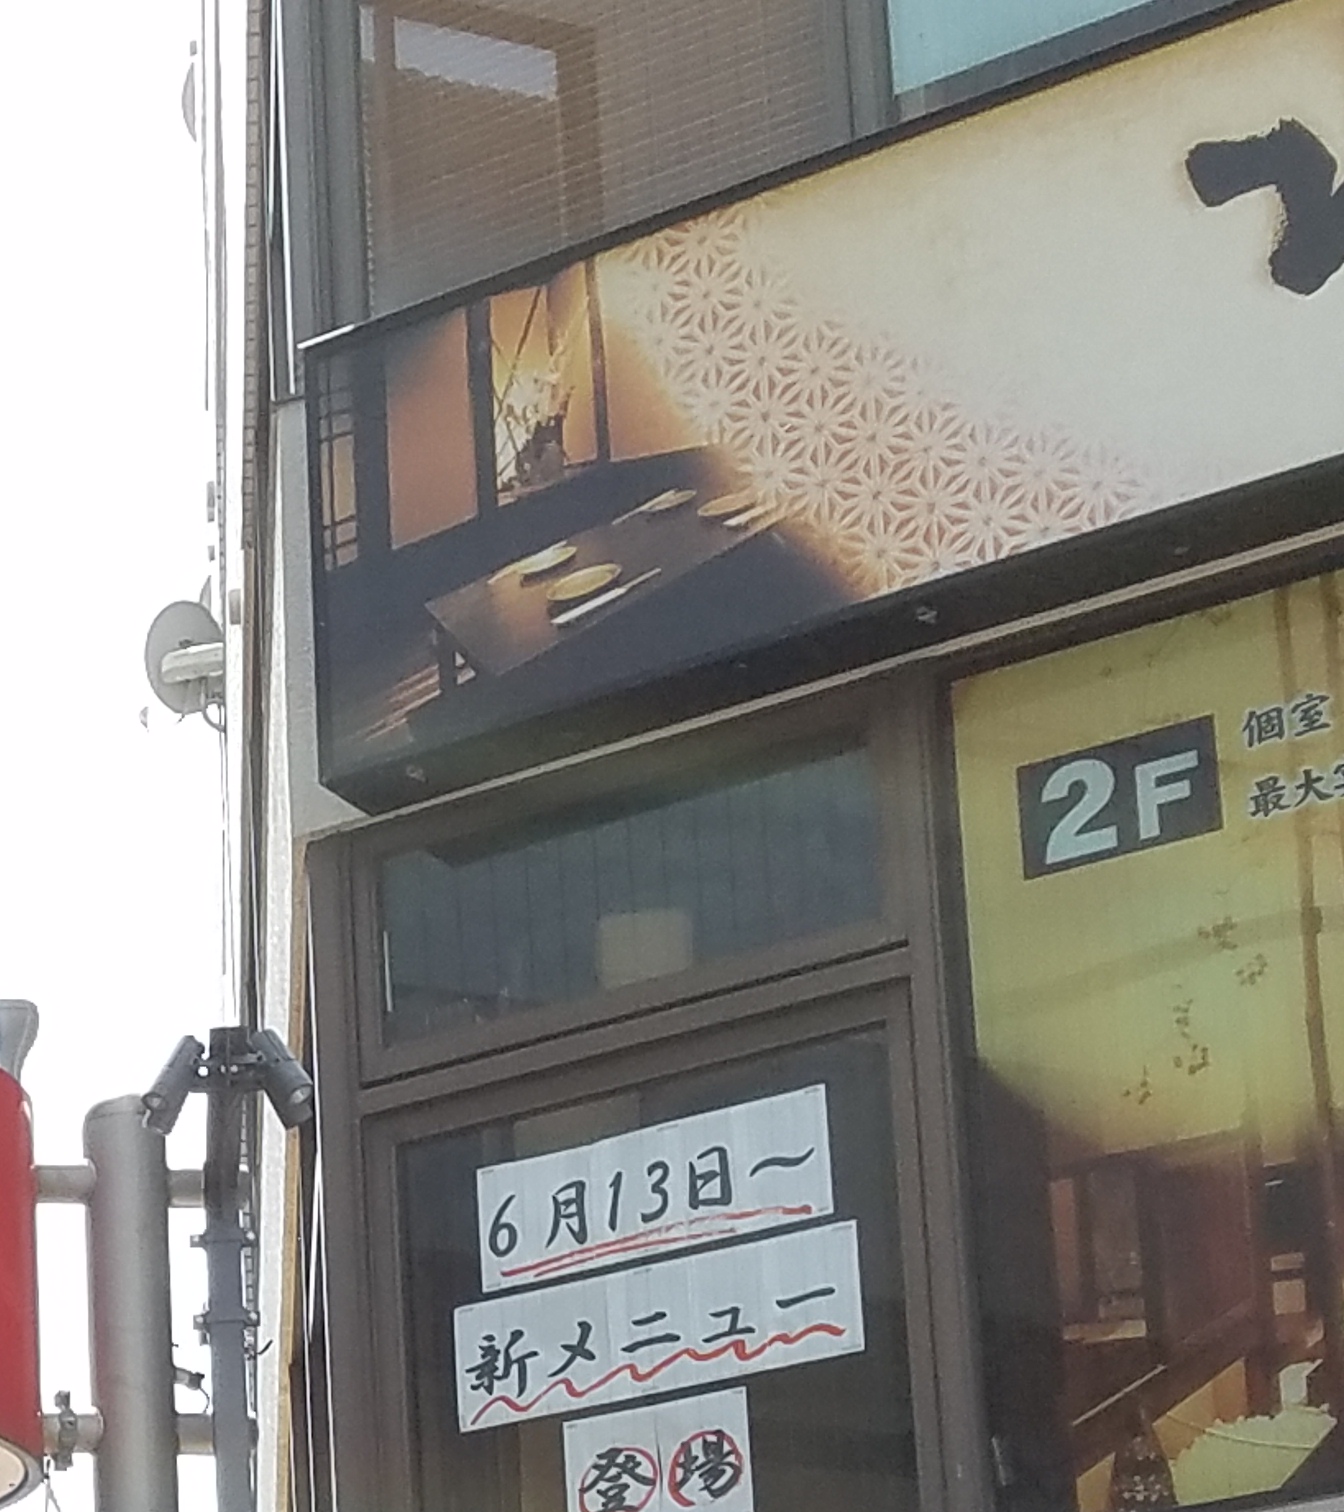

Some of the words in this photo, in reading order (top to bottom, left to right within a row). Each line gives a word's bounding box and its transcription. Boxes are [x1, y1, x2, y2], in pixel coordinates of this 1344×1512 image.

[1242, 693, 1330, 748] 個室
[1041, 749, 1199, 865] 2F
[1250, 762, 1344, 819] 最大
